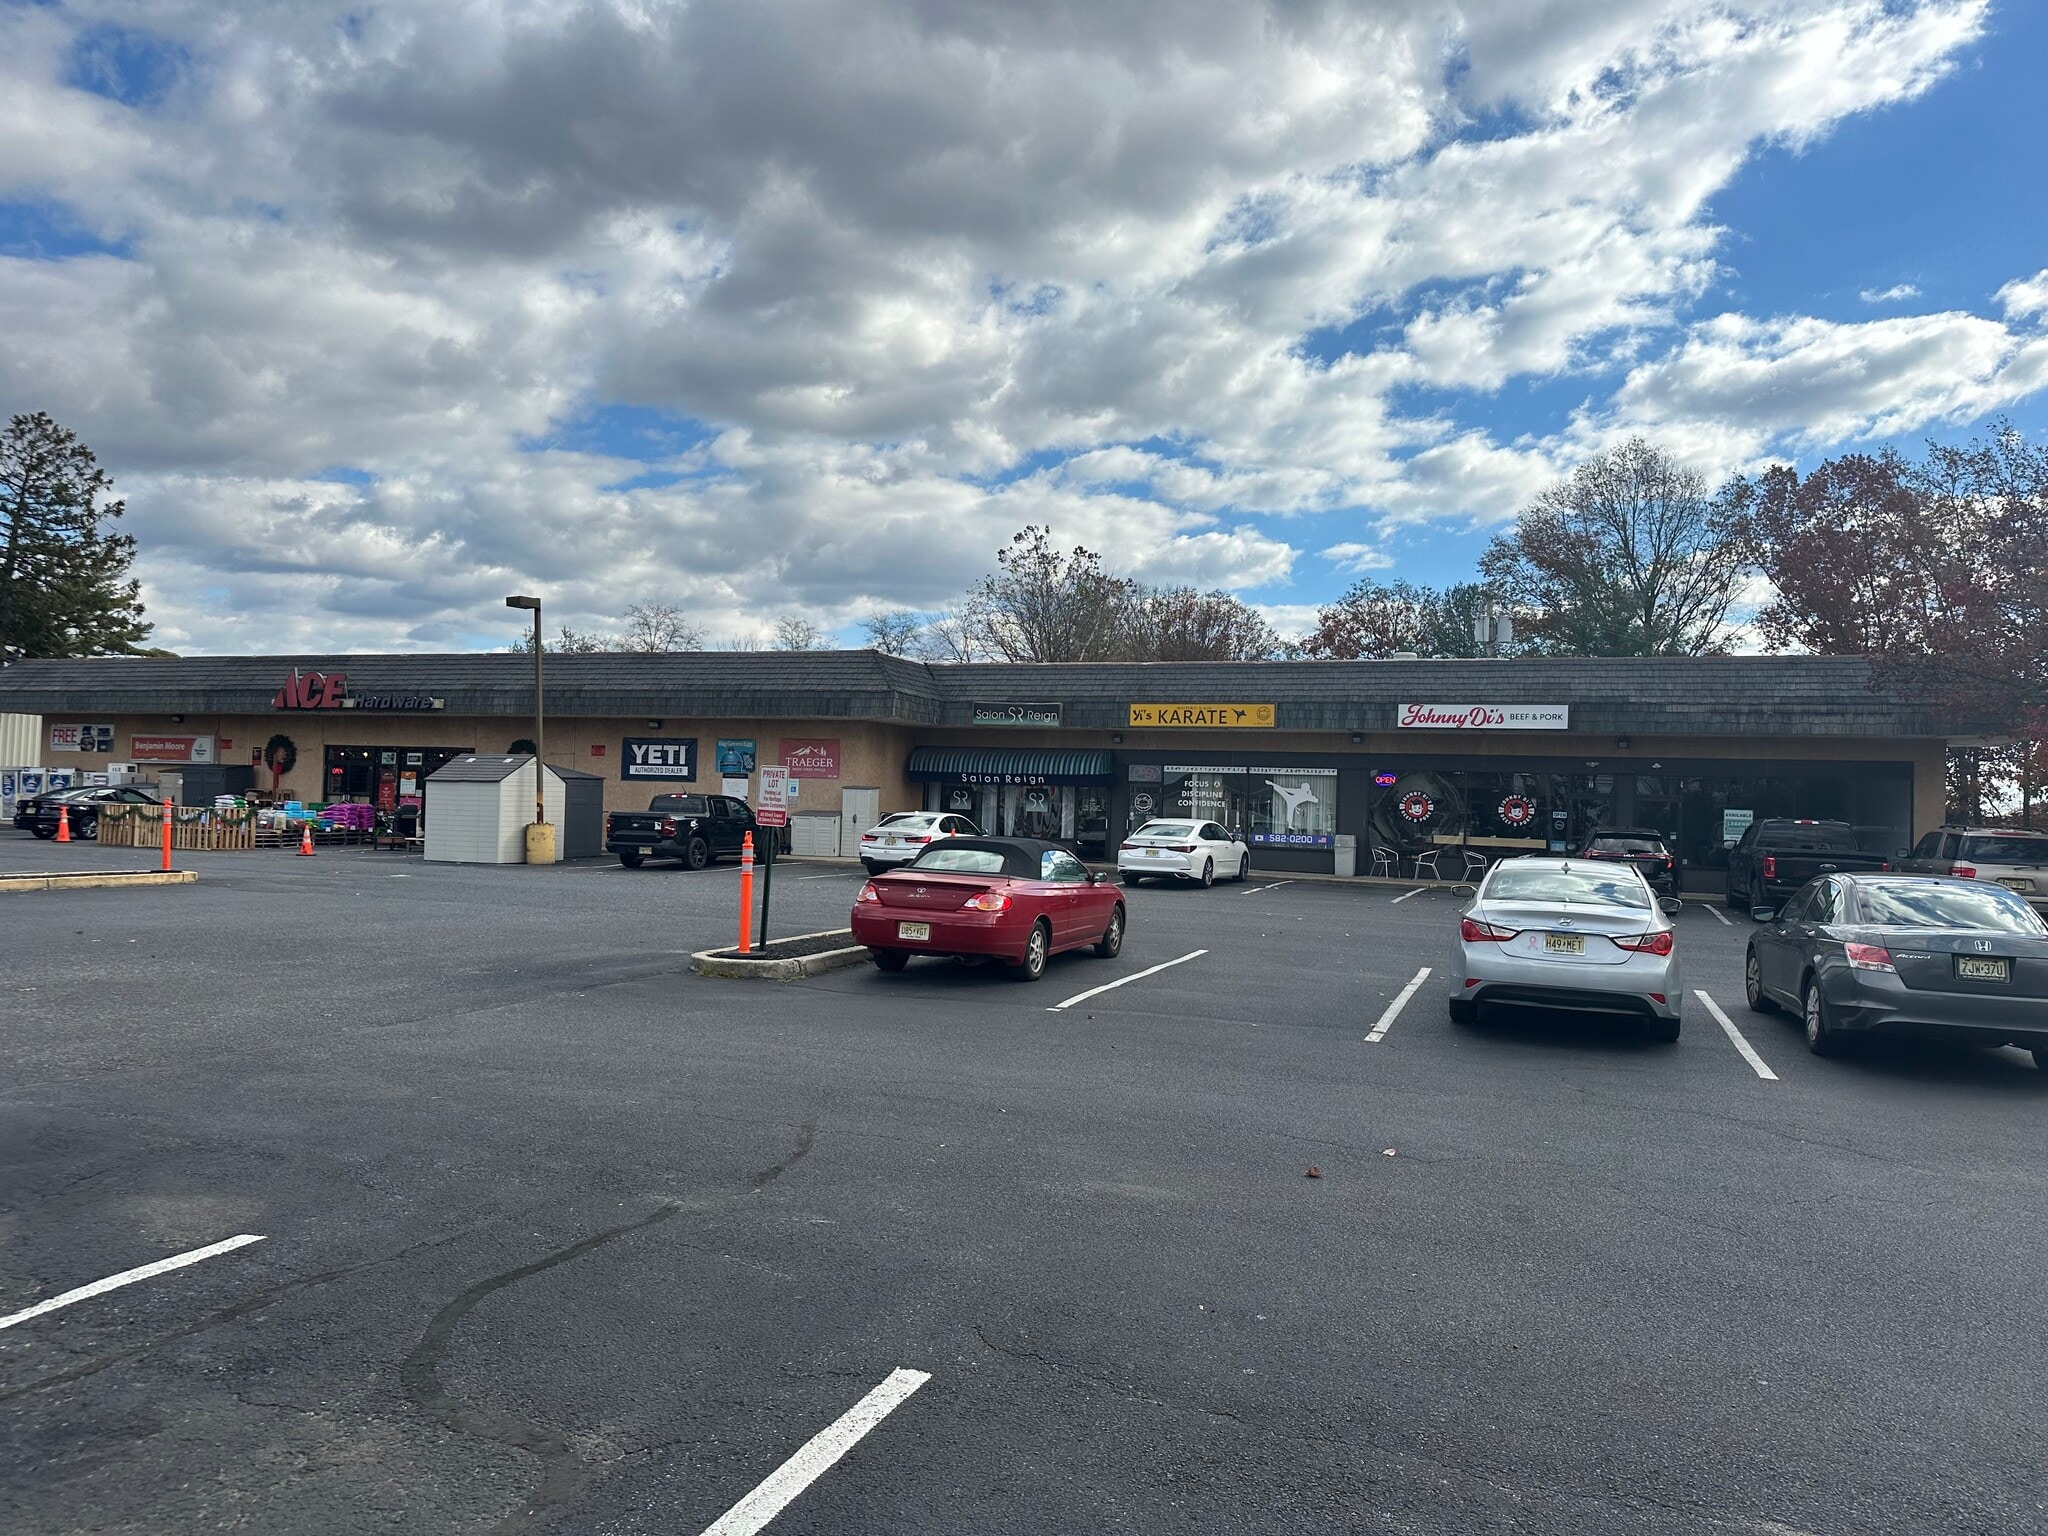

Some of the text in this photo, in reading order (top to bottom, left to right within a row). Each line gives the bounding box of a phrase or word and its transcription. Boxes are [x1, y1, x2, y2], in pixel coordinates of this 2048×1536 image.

[271, 667, 432, 709] ACE Hardware
[976, 709, 1005, 720] Salon
[1027, 710, 1058, 723] Reign
[1158, 709, 1228, 725] KARATE
[1401, 703, 1564, 729] Johnny Di's BEEF & PORK
[52, 728, 78, 743] FREE
[135, 741, 185, 751] Benjamin Moore
[631, 744, 686, 765] YETI
[785, 757, 833, 767] TRAEGER
[762, 769, 786, 779] PRIVATE
[961, 773, 1045, 785] Salon Reign
[768, 779, 779, 788] LOT
[1184, 780, 1209, 788] FOCUS
[1375, 776, 1396, 784] OPEN
[1181, 790, 1223, 799] DISCIPLINE
[1177, 799, 1226, 808] CONFIDENCE
